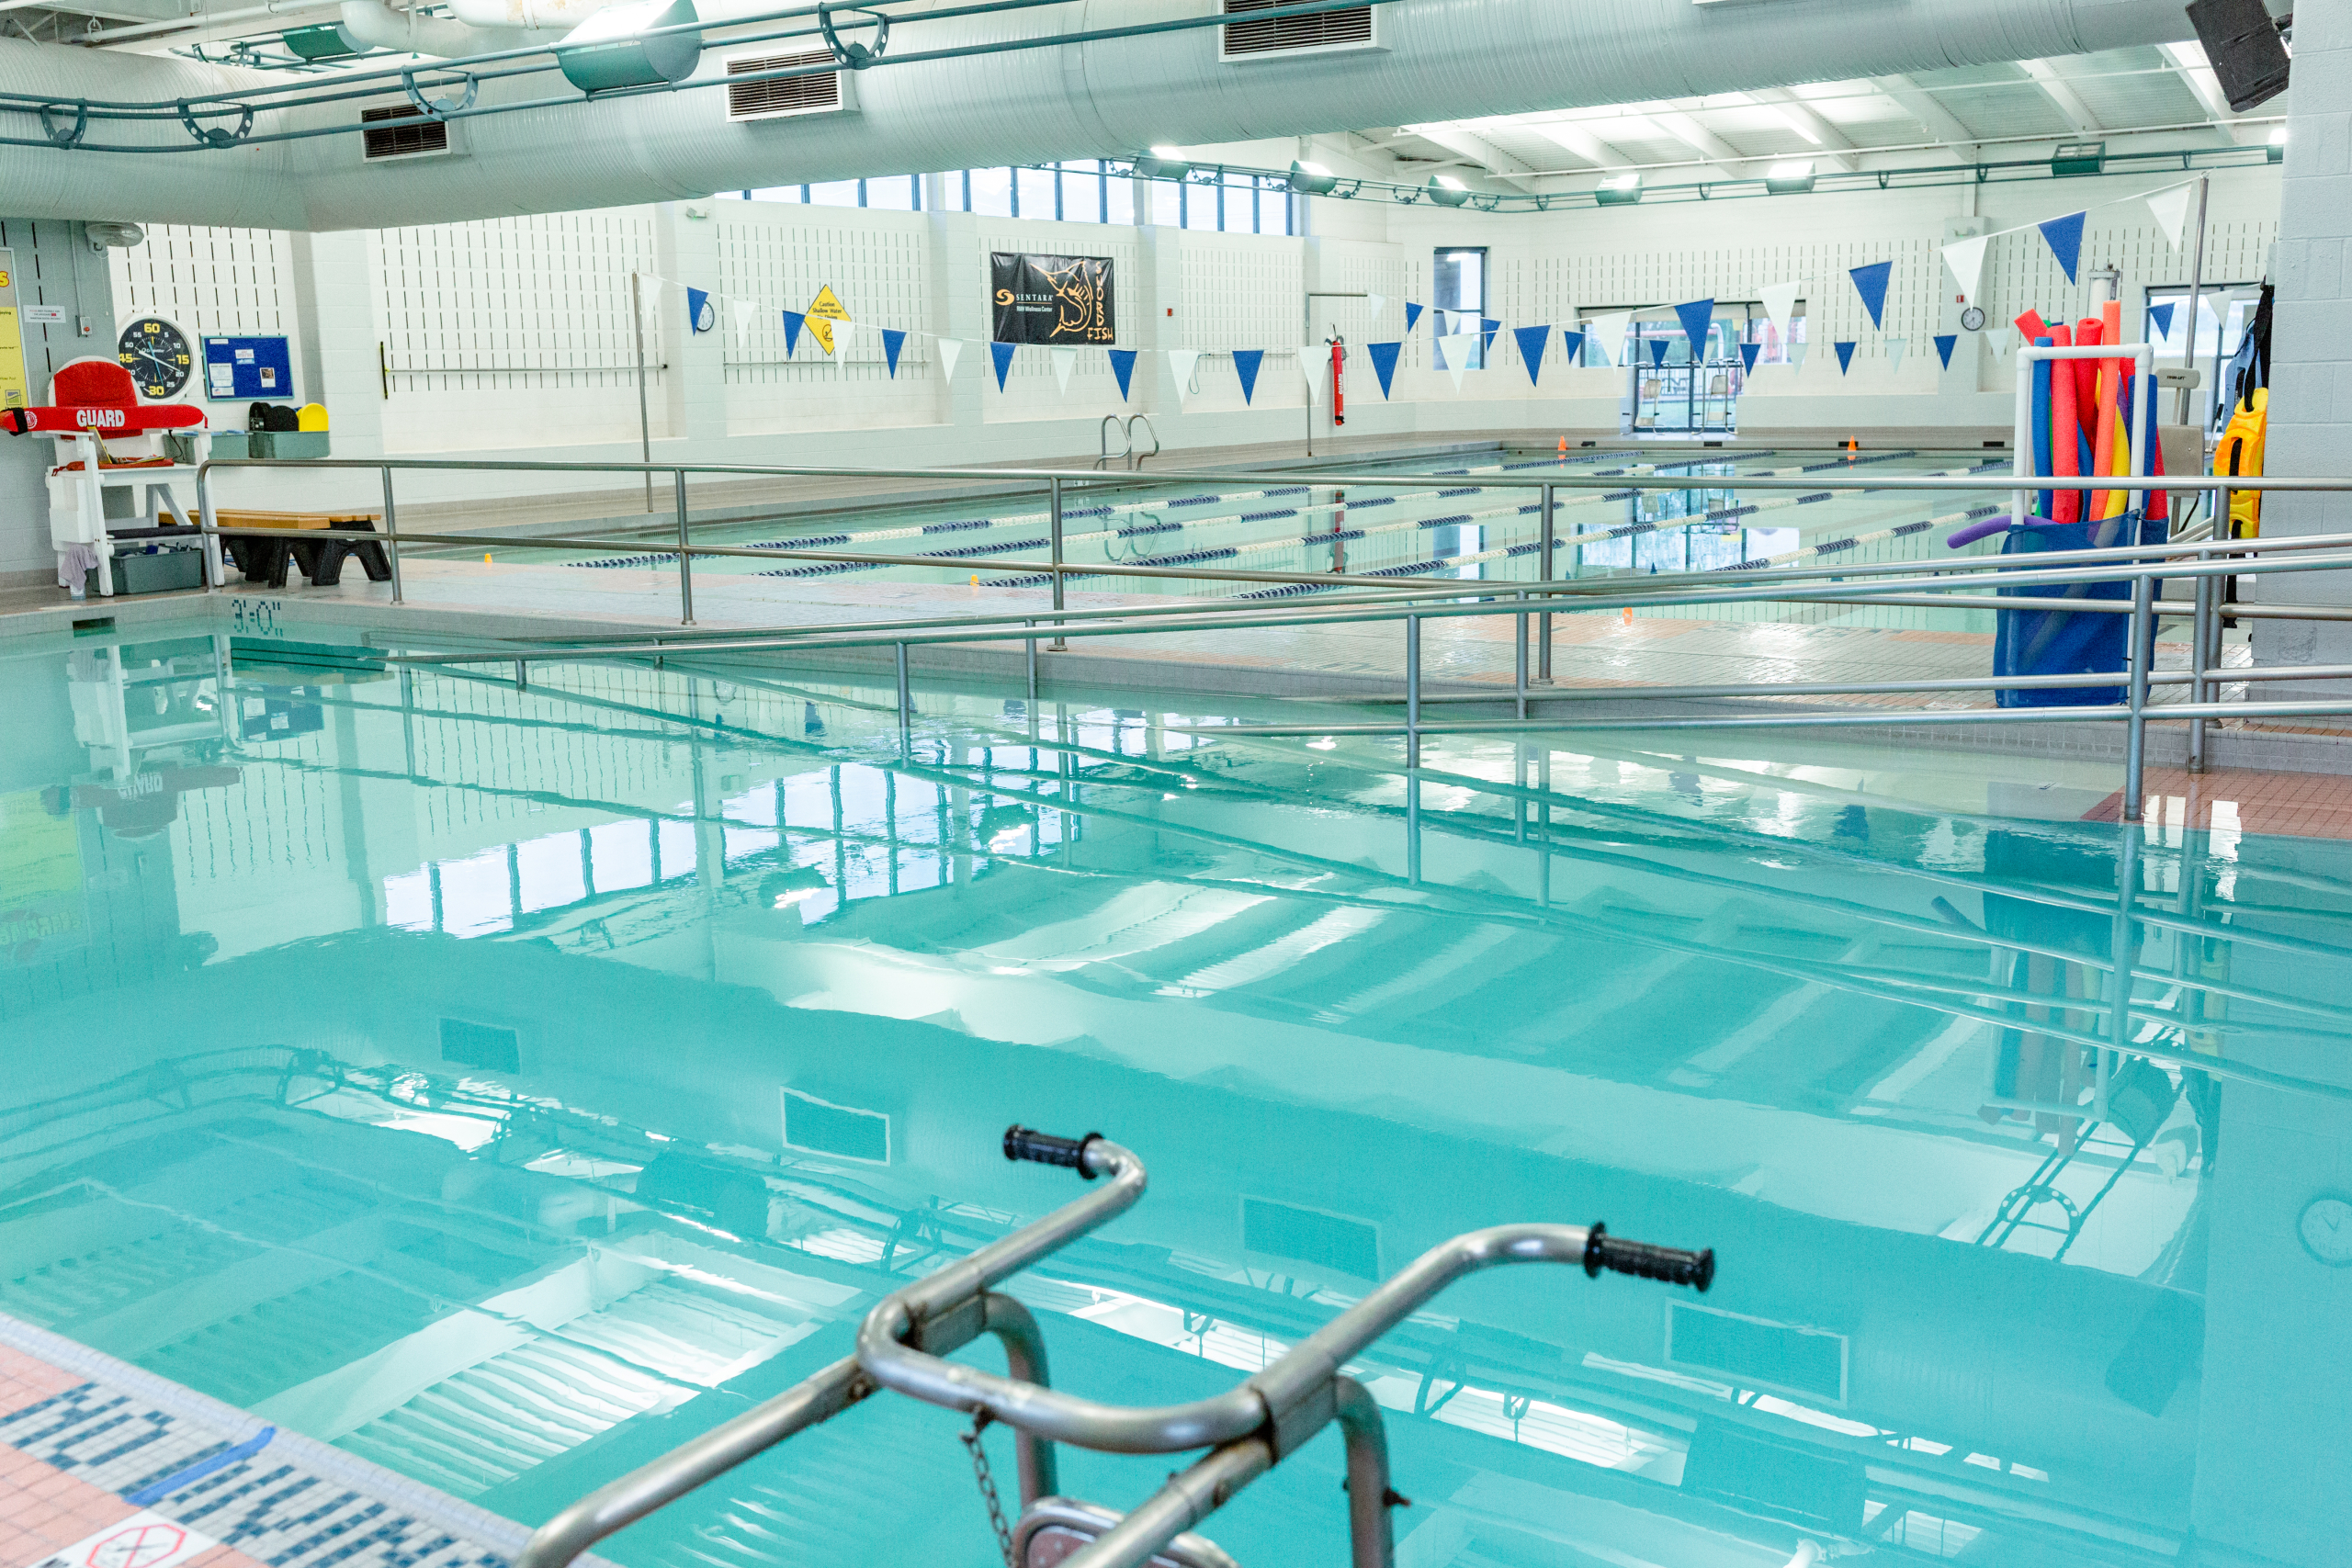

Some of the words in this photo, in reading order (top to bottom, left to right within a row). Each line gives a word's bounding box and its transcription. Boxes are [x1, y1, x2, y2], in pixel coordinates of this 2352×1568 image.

[1016, 293, 1053, 301] SENTARA
[143, 322, 161, 333] 60
[1087, 327, 1114, 341] FISH
[119, 353, 133, 363] 45
[175, 354, 190, 365] 15
[148, 386, 164, 396] 30
[76, 409, 126, 428] GUARD
